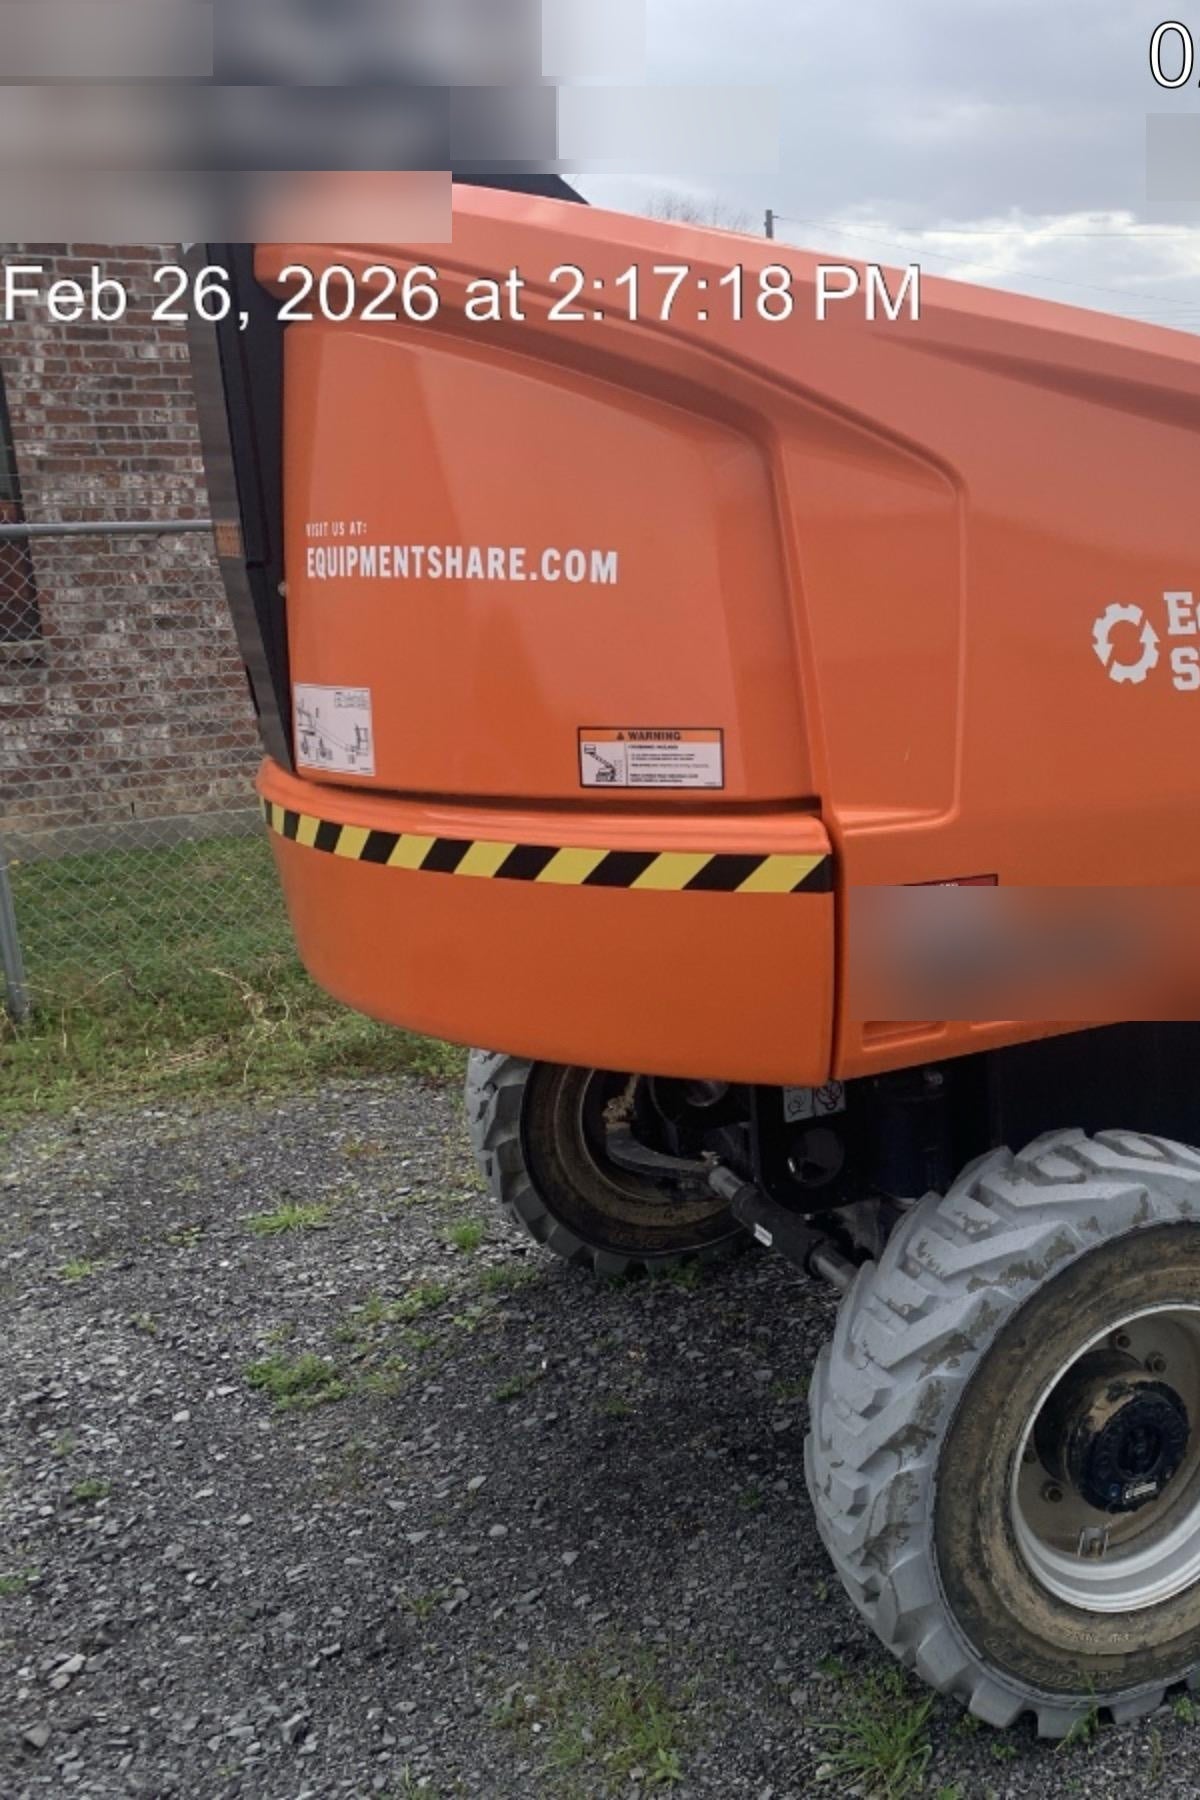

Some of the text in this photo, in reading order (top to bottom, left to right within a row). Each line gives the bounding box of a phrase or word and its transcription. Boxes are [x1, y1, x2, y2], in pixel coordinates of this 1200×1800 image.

[332, 521, 346, 536] US
[349, 521, 368, 536] AT:
[306, 545, 619, 585] EQUIPMENTSHARE.COM
[627, 731, 682, 741] WARNING
